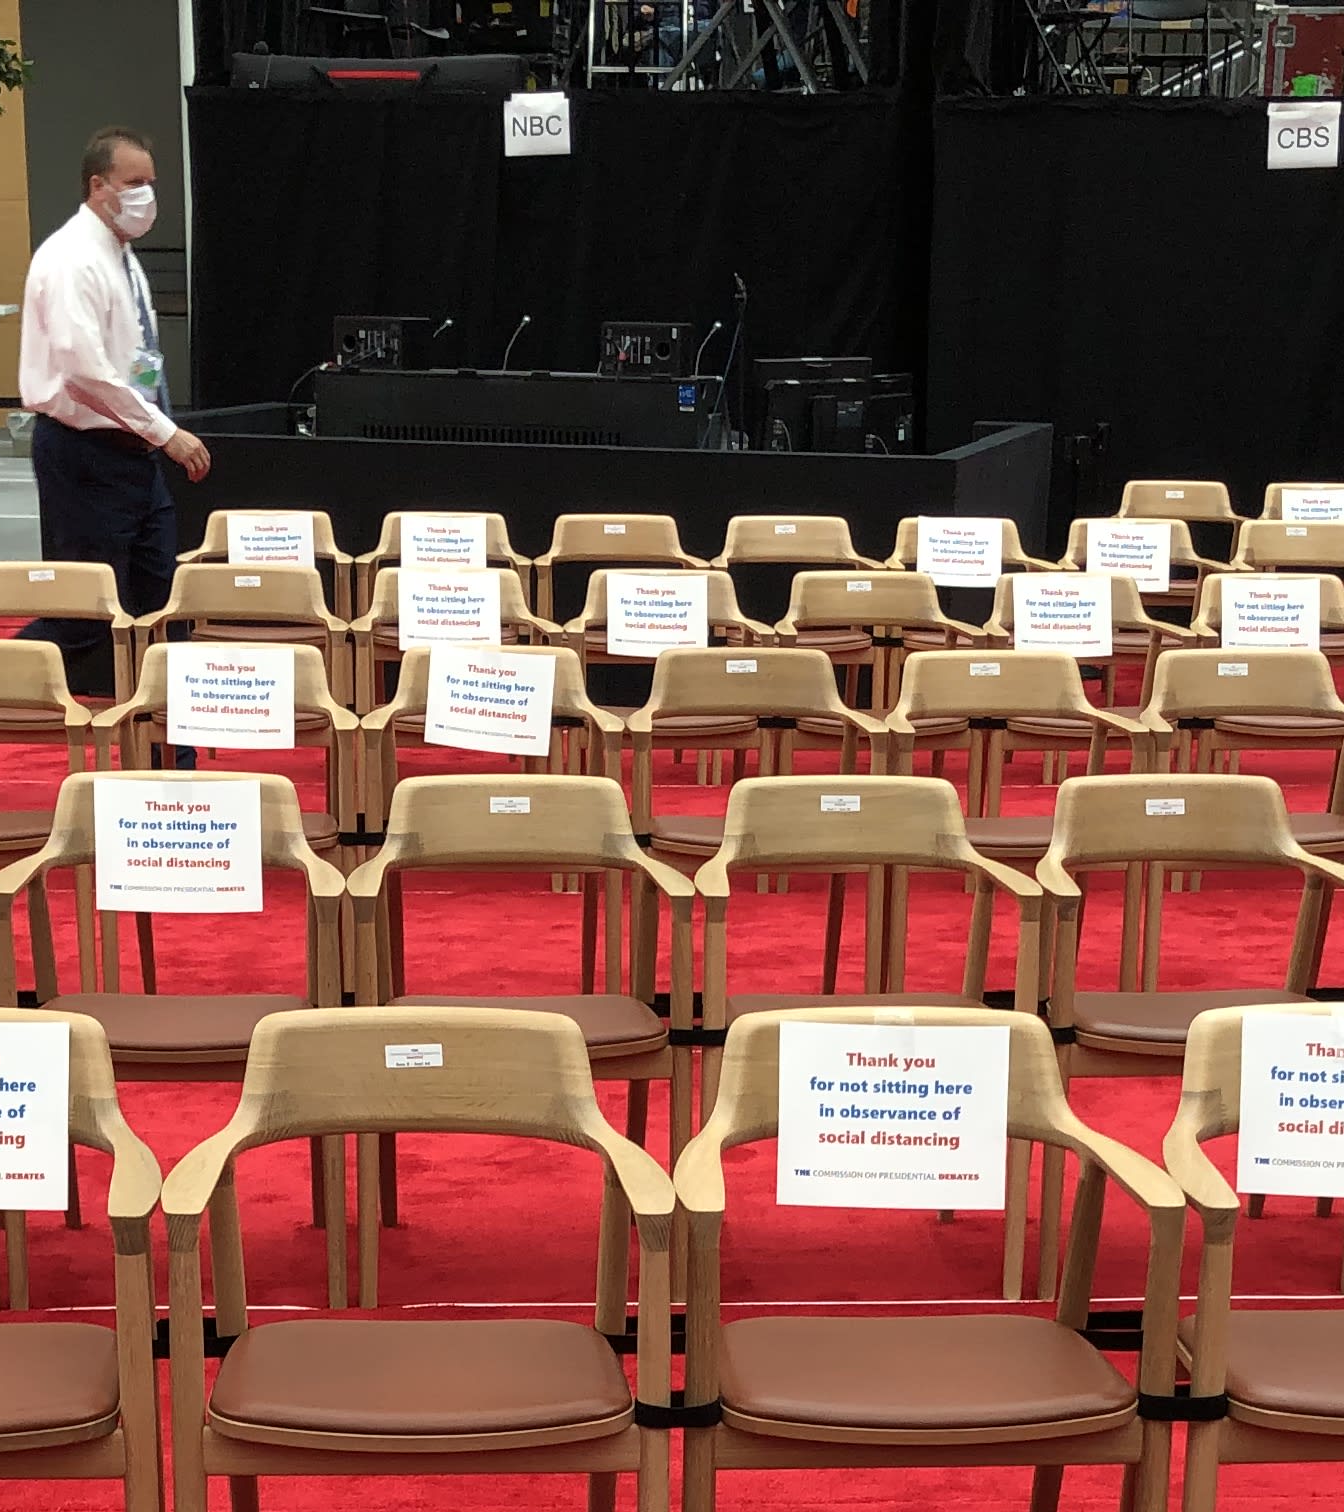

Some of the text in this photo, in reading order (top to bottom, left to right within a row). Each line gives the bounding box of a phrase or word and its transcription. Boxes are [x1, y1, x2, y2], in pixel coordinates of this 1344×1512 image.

[512, 115, 562, 137] NBC
[1278, 126, 1330, 149] CBS
[205, 662, 256, 674] Thank you
[185, 675, 200, 684] for
[221, 678, 252, 688] sitting
[255, 678, 276, 686] here
[191, 690, 270, 700] in observance of
[191, 705, 270, 718] social distancing
[846, 1052, 935, 1072] Thank you
[1271, 1066, 1295, 1081] for
[1299, 1071, 1327, 1083] not
[0, 1077, 36, 1092] here
[810, 1076, 972, 1098] for not sitting here
[1280, 1092, 1294, 1107] in
[8, 1104, 26, 1118] of
[820, 1103, 961, 1120] in observance of
[1278, 1120, 1324, 1134] social
[819, 1130, 960, 1150] social distancing
[5, 1172, 45, 1180] DEBATES
[813, 1170, 863, 1178] COMMISSION
[879, 1172, 936, 1180] PRESIDENTIAL
[938, 1173, 980, 1181] DEBATES
